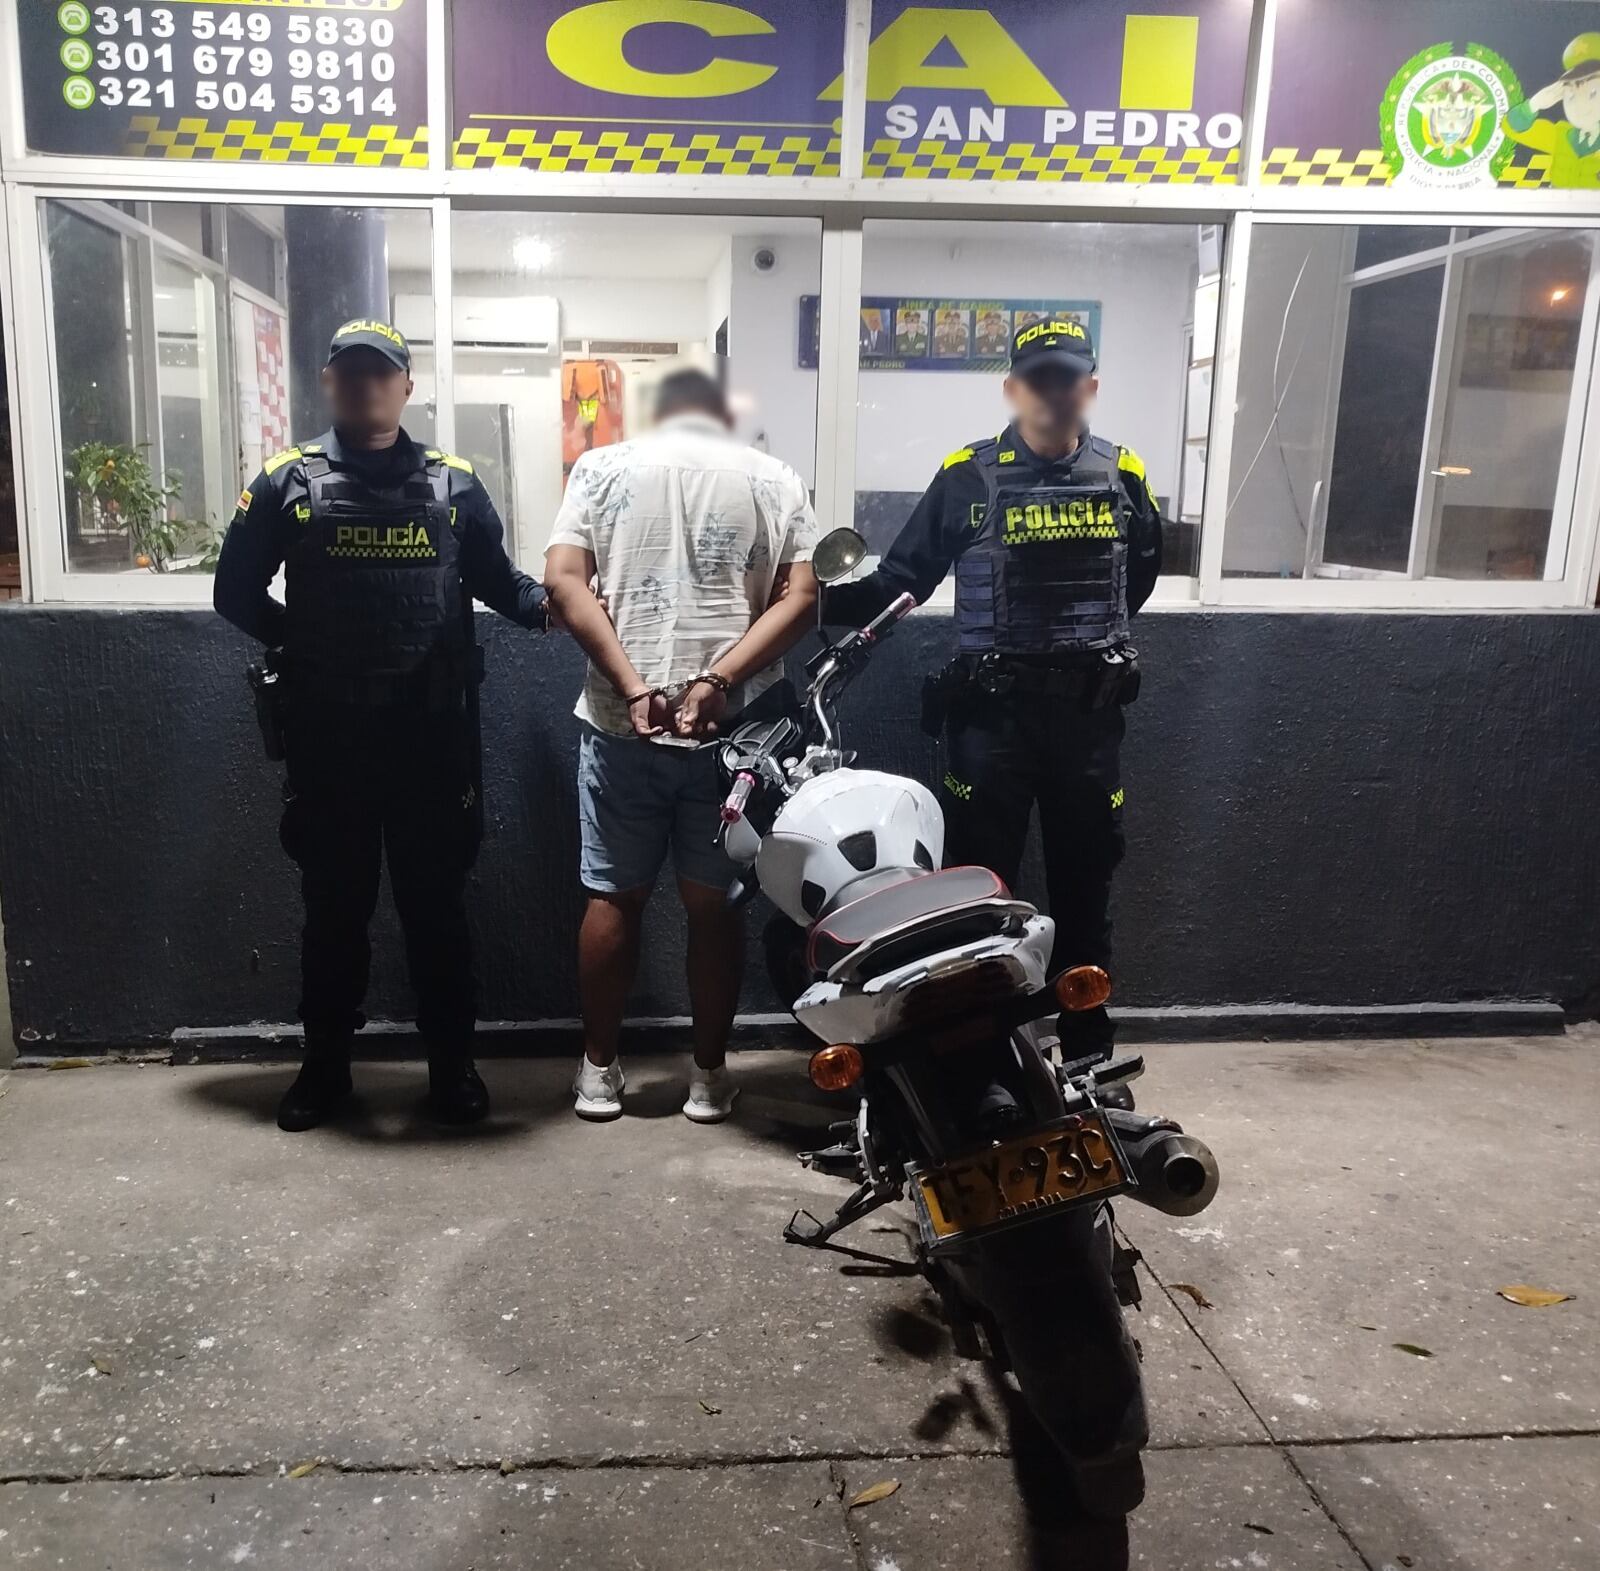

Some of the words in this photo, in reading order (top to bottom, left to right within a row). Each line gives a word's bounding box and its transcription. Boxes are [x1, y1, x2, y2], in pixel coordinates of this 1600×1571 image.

[94, 6, 175, 37] 313
[192, 11, 271, 41] 549
[288, 15, 394, 47] 5830
[97, 41, 173, 73] 301
[193, 46, 273, 77] 679
[288, 50, 395, 82] 9810
[546, 0, 1200, 110] CAI
[1452, 60, 1468, 69] DE
[99, 77, 175, 108] 321
[196, 81, 275, 112] 504
[291, 85, 396, 116] 5314
[885, 104, 1007, 142] SAN
[1043, 110, 1244, 149] PEDRO
[336, 522, 430, 546] POLICÍA
[1005, 497, 1114, 532] POLICÍA
